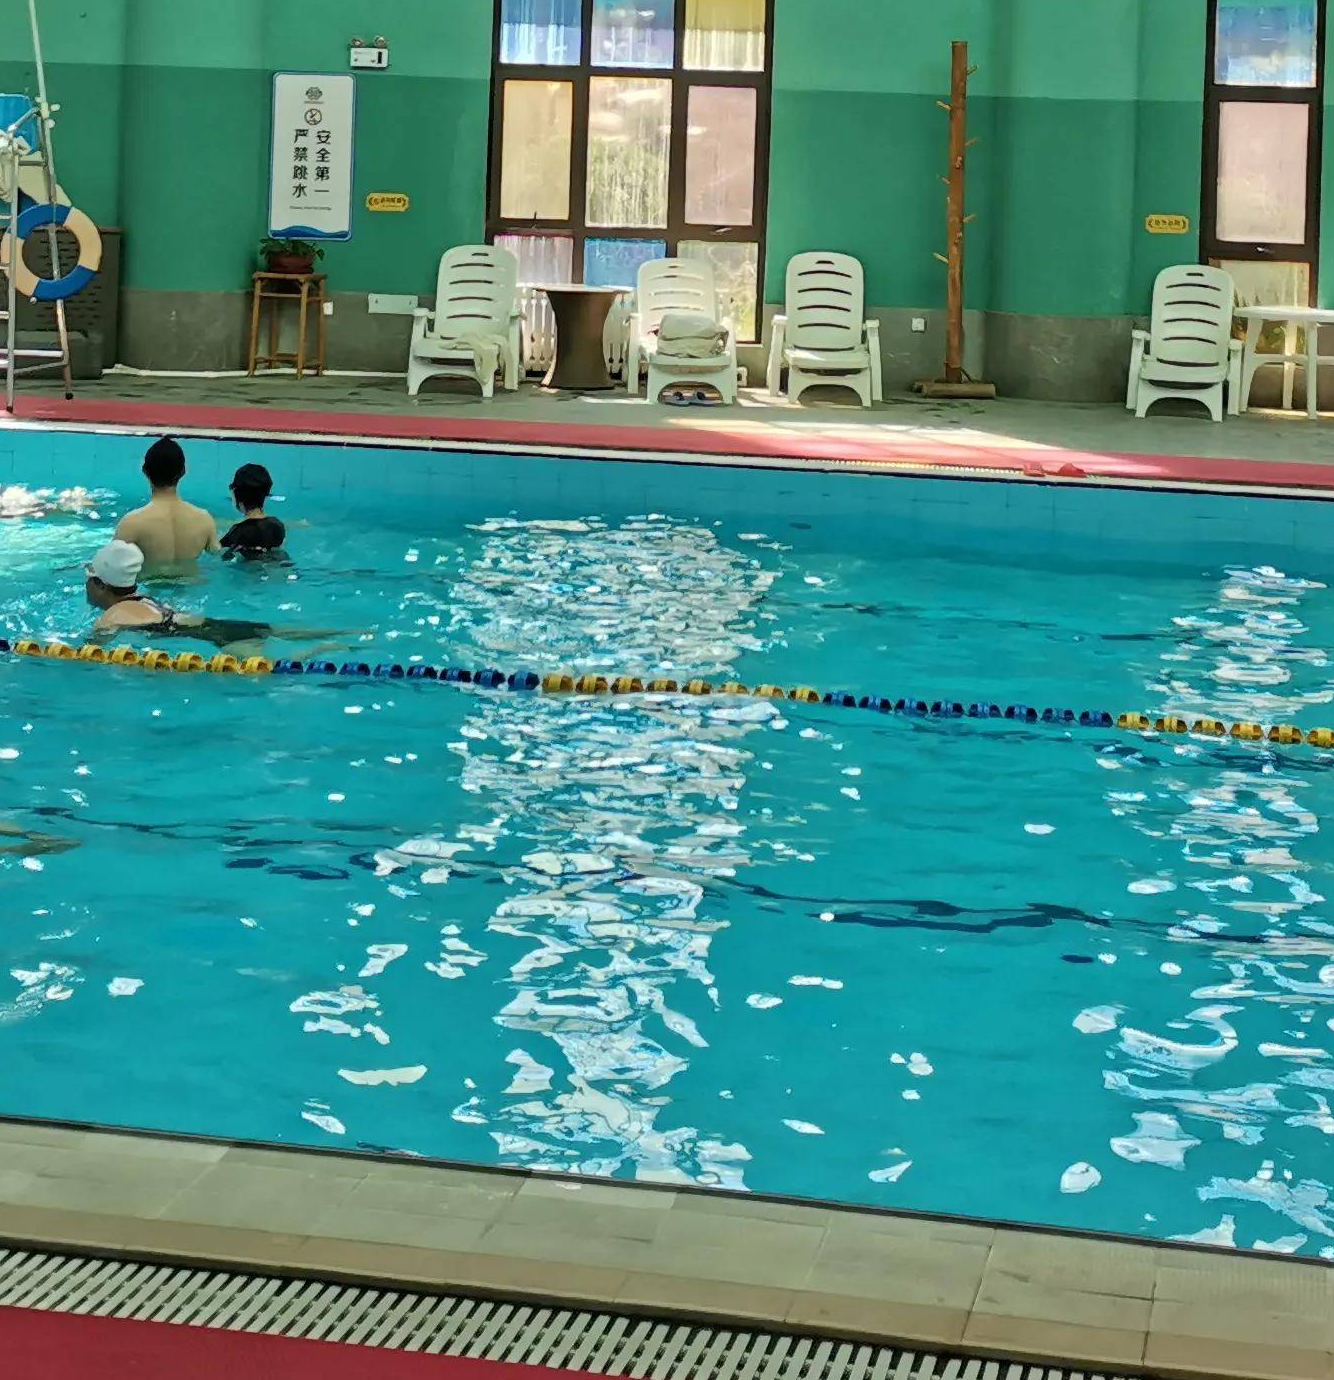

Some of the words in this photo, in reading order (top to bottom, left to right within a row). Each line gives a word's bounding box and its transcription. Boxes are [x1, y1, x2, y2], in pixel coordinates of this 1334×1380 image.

[292, 128, 309, 198] 严禁跳水
[314, 130, 331, 193] 安全第一
